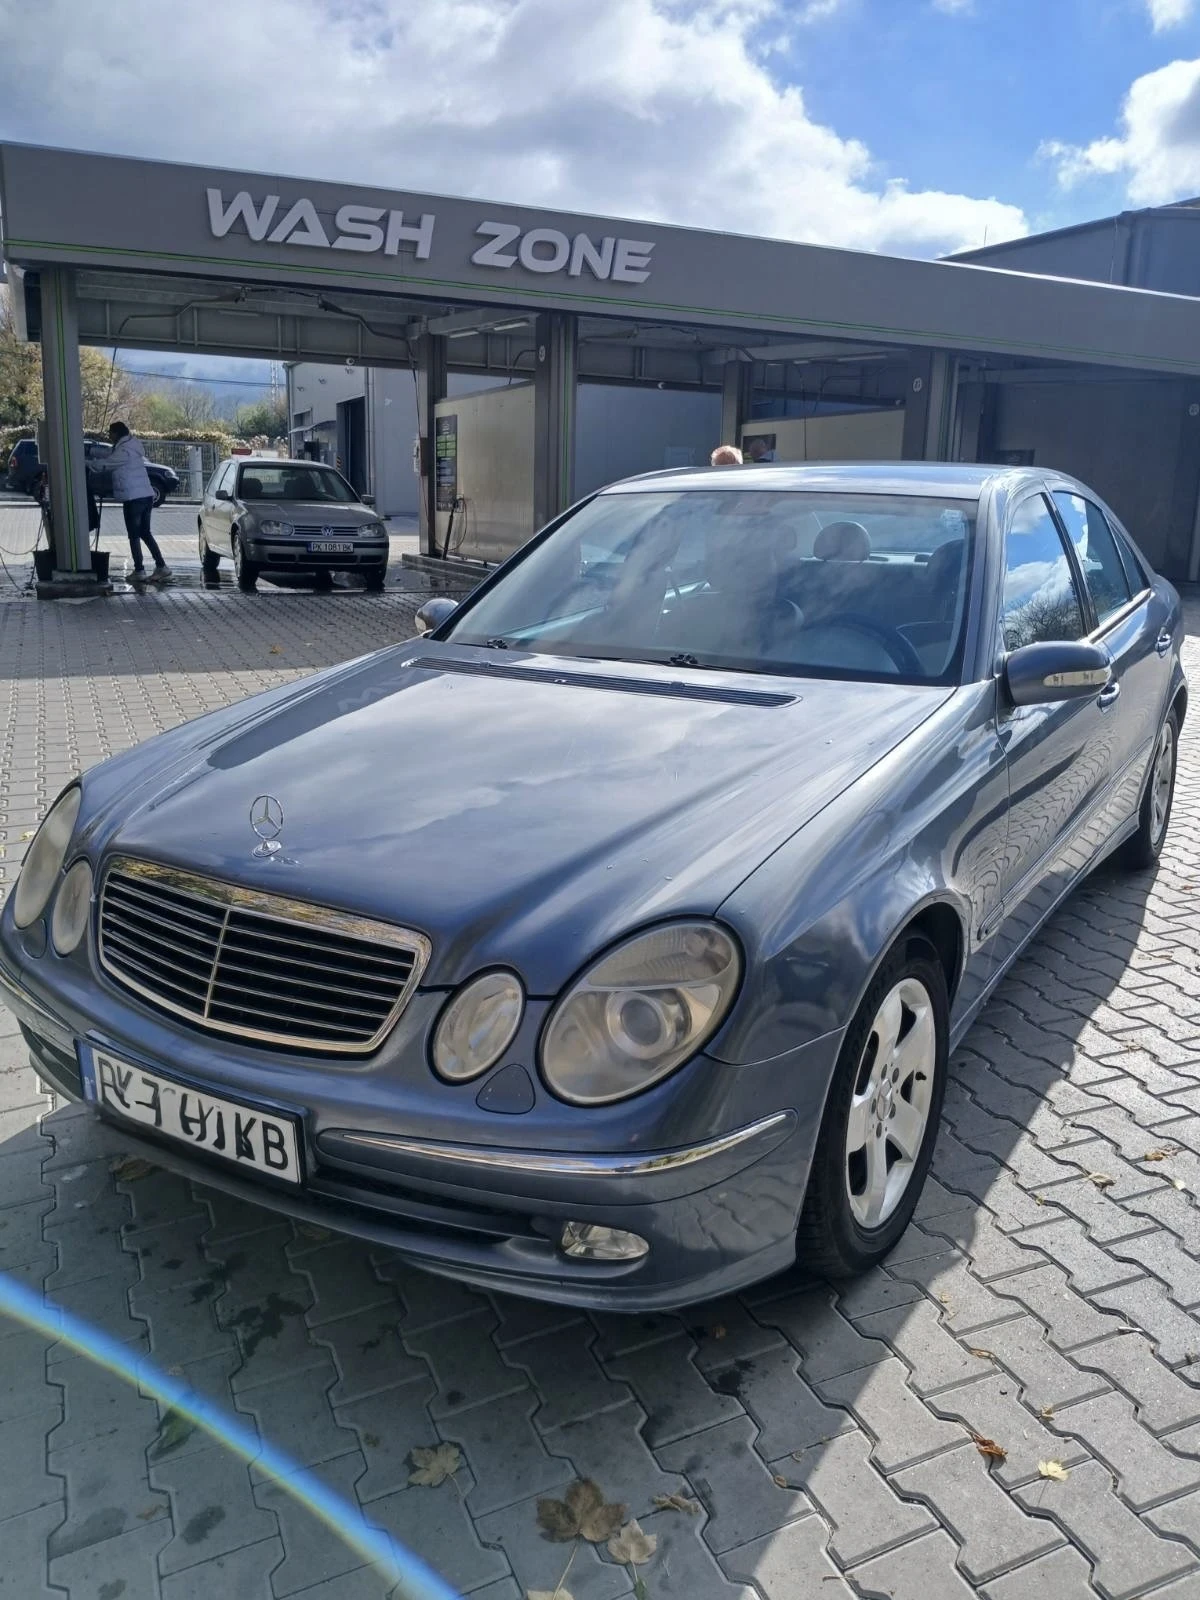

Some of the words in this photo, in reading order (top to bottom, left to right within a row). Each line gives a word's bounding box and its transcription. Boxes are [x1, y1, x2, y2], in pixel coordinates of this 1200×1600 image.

[207, 188, 435, 259] WASH
[471, 221, 656, 283] ZONE
[325, 543, 340, 551] 1081
